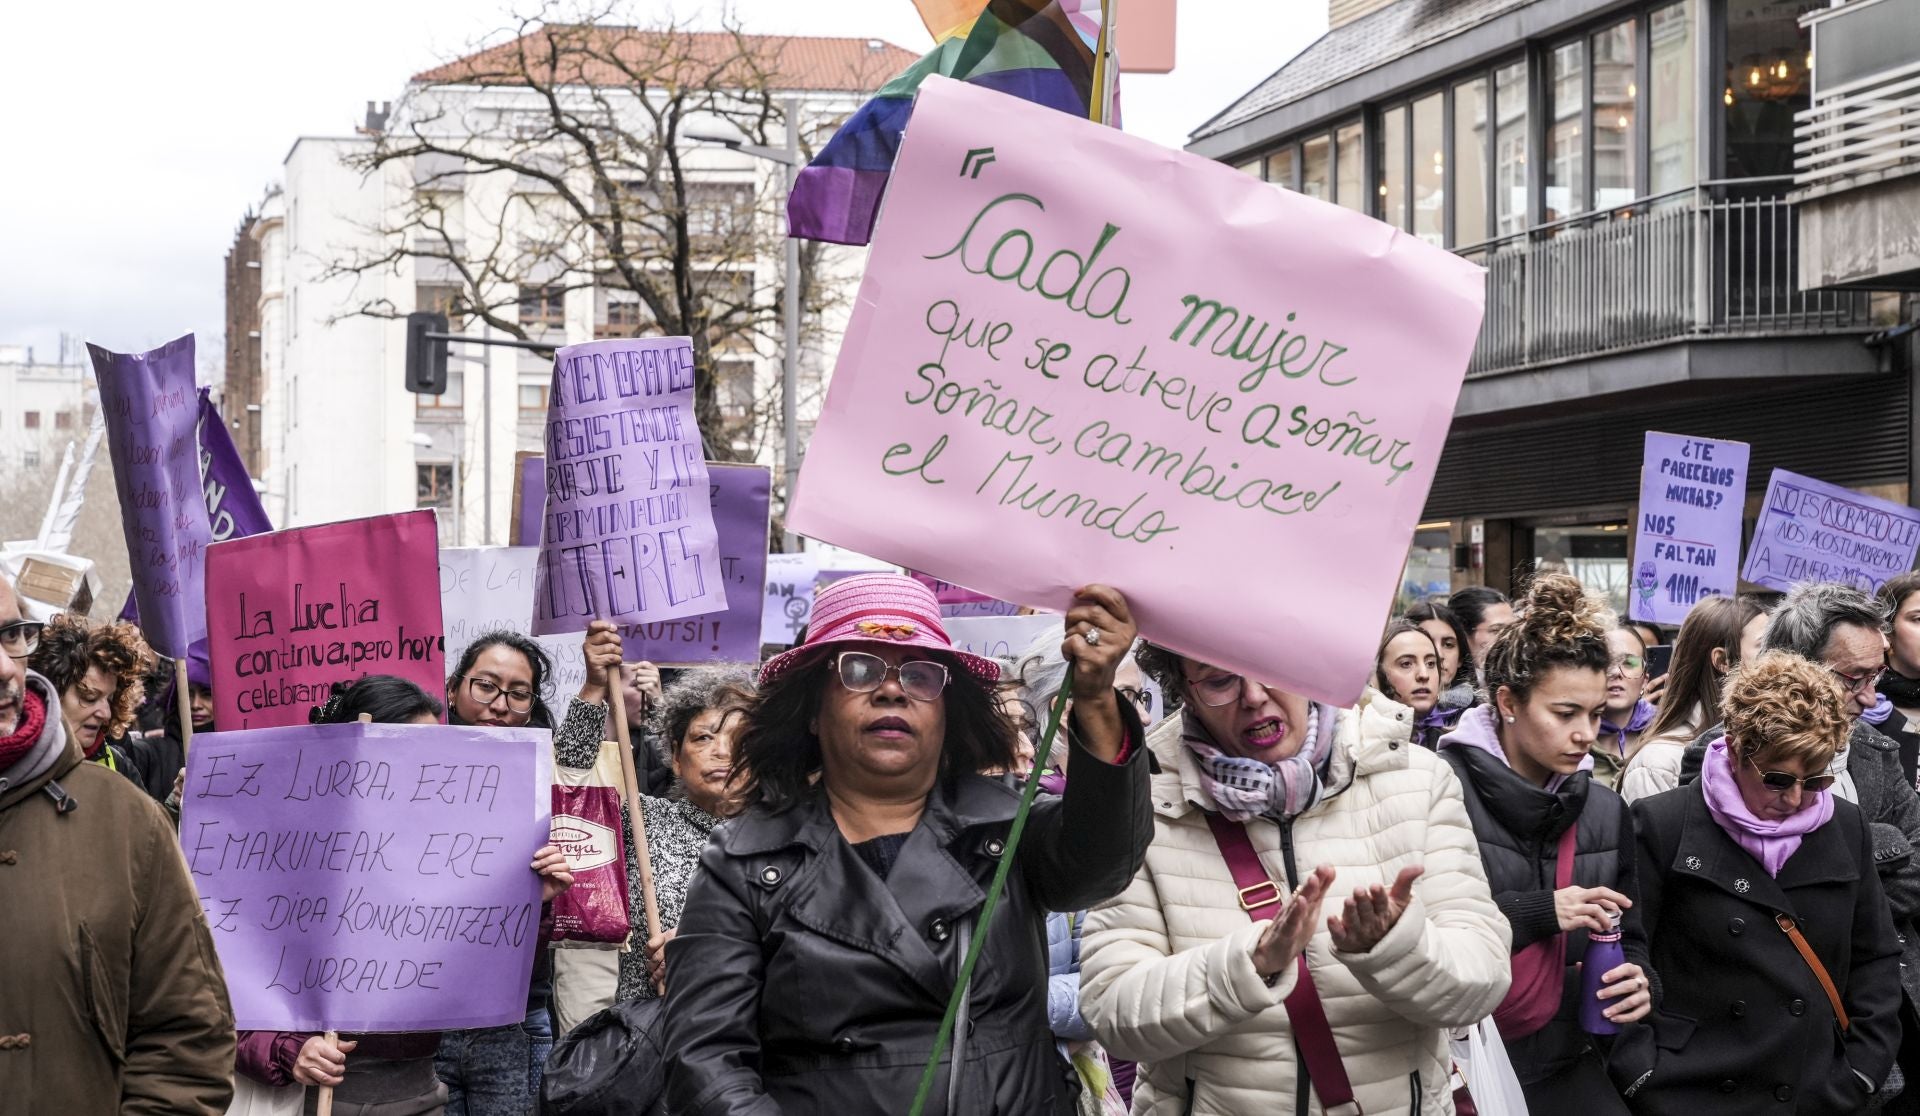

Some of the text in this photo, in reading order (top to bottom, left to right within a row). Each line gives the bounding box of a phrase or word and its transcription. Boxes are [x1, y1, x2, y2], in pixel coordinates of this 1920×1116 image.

[922, 192, 1358, 393] Cada mujer
[926, 299, 1014, 368] que
[1024, 338, 1072, 380] se
[1083, 345, 1233, 434] atreve
[643, 449, 660, 490] Y
[881, 433, 949, 485] el
[1660, 457, 1735, 487] PARECEMOS
[1665, 483, 1724, 511] MUCHAS?
[1773, 486, 1801, 513] NO
[1800, 495, 1820, 519] ES
[1887, 518, 1917, 547] QUE
[1643, 513, 1676, 536] NOS
[1778, 521, 1903, 572] NOS ACOSTUMBREMOS
[1654, 541, 1717, 567] FALTAN
[1755, 546, 1771, 573] A
[1784, 553, 1830, 583] TENER
[234, 592, 275, 641] La
[409, 763, 501, 813] EZTA
[190, 821, 504, 879] EMAKUMEAK ERE
[264, 945, 444, 995] LURRALDE
